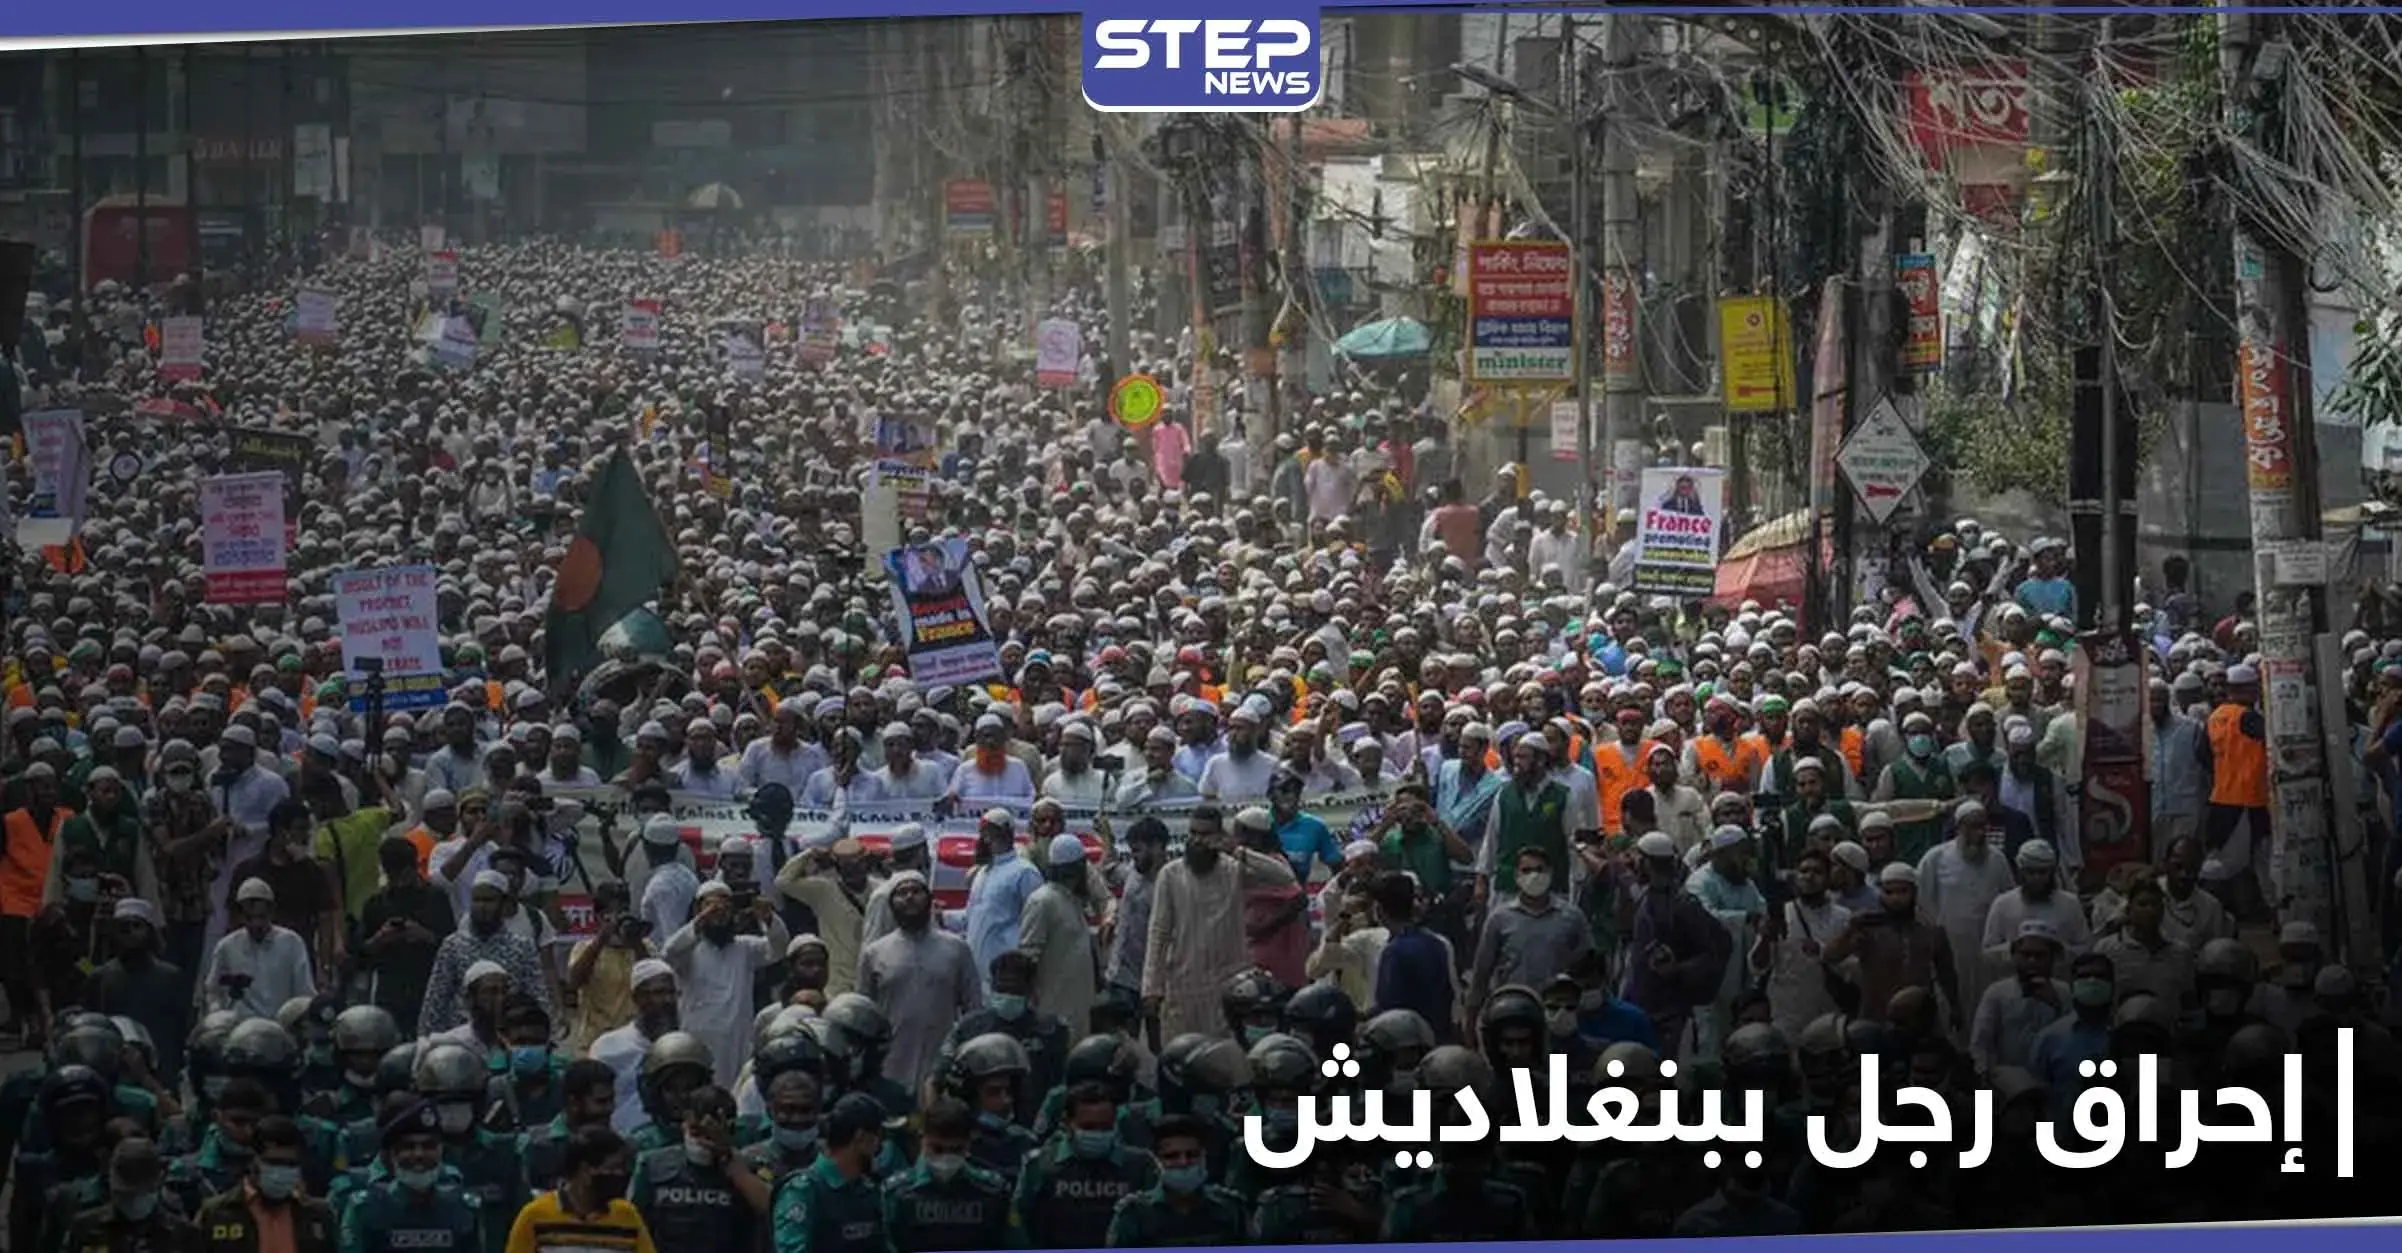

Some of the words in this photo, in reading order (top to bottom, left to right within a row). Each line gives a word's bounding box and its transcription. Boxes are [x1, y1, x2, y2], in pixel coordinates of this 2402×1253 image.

[1478, 351, 1567, 371] minister
[1645, 510, 1712, 533] France
[1643, 533, 1711, 548] promoting
[405, 572, 428, 587] THE
[915, 610, 955, 626] made
[957, 607, 973, 621] in
[917, 621, 976, 643] France
[655, 1187, 731, 1206] POLICE
[1055, 1180, 1130, 1198] POLICE
